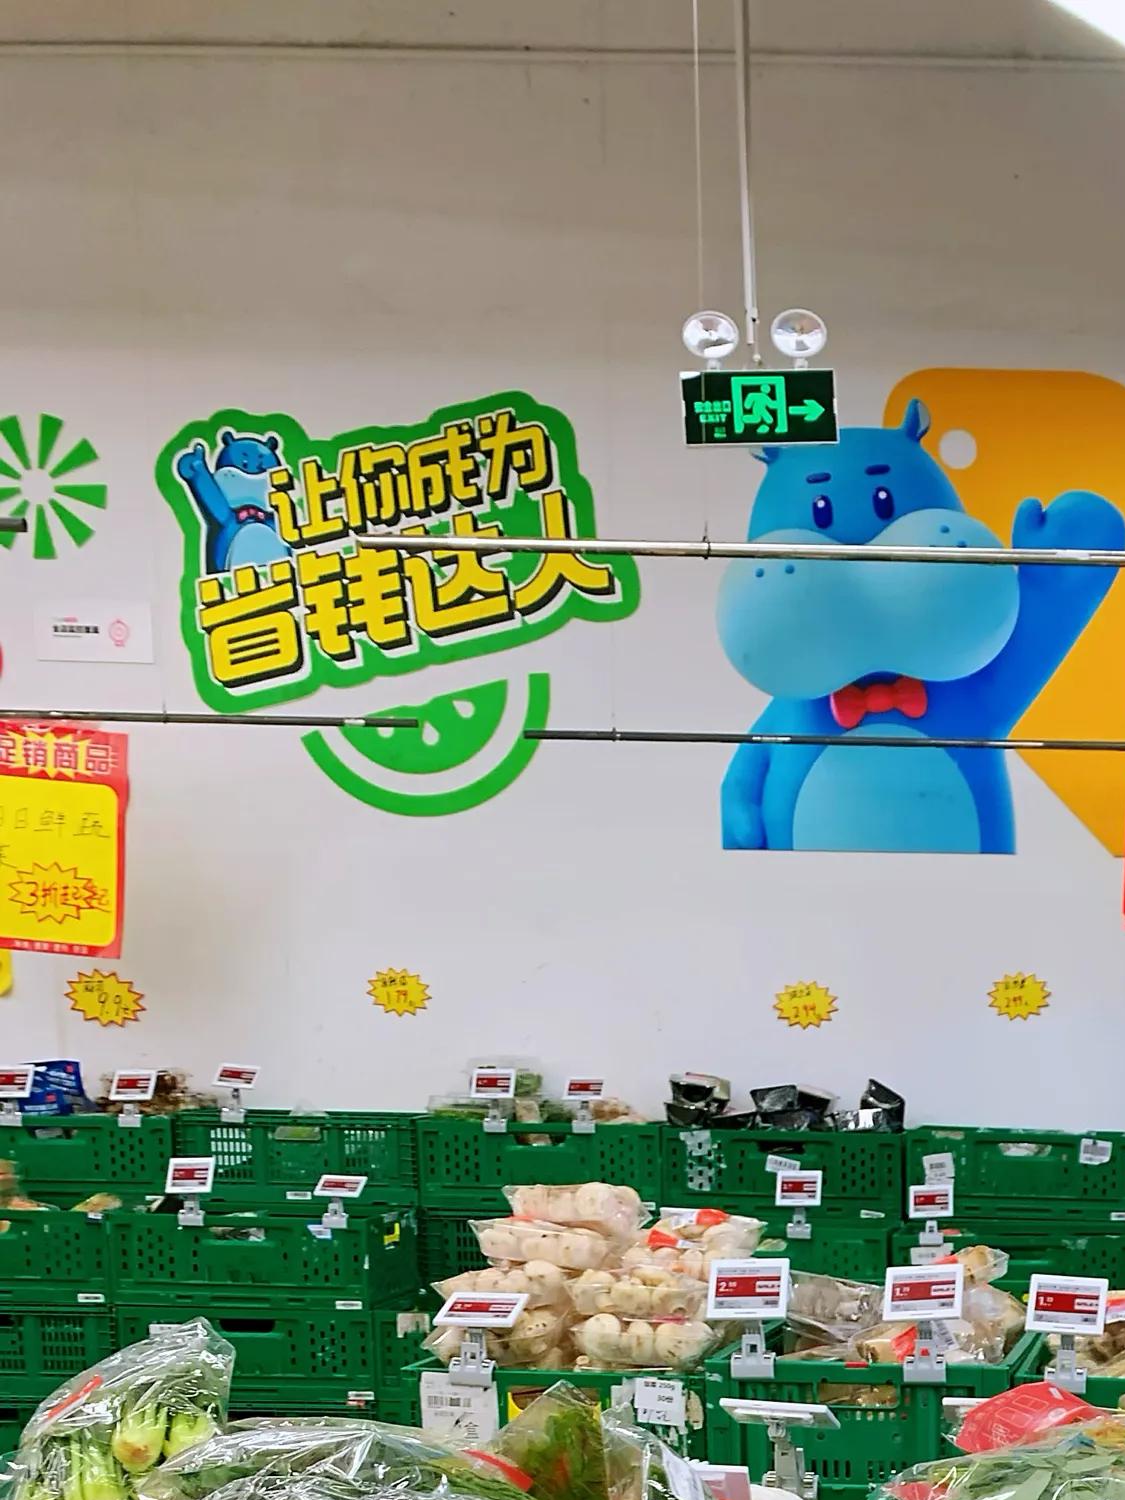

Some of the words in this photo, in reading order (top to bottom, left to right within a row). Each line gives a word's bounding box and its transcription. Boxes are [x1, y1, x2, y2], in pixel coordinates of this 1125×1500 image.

[268, 407, 552, 548] 让你成为
[197, 490, 615, 688] 省钱达人
